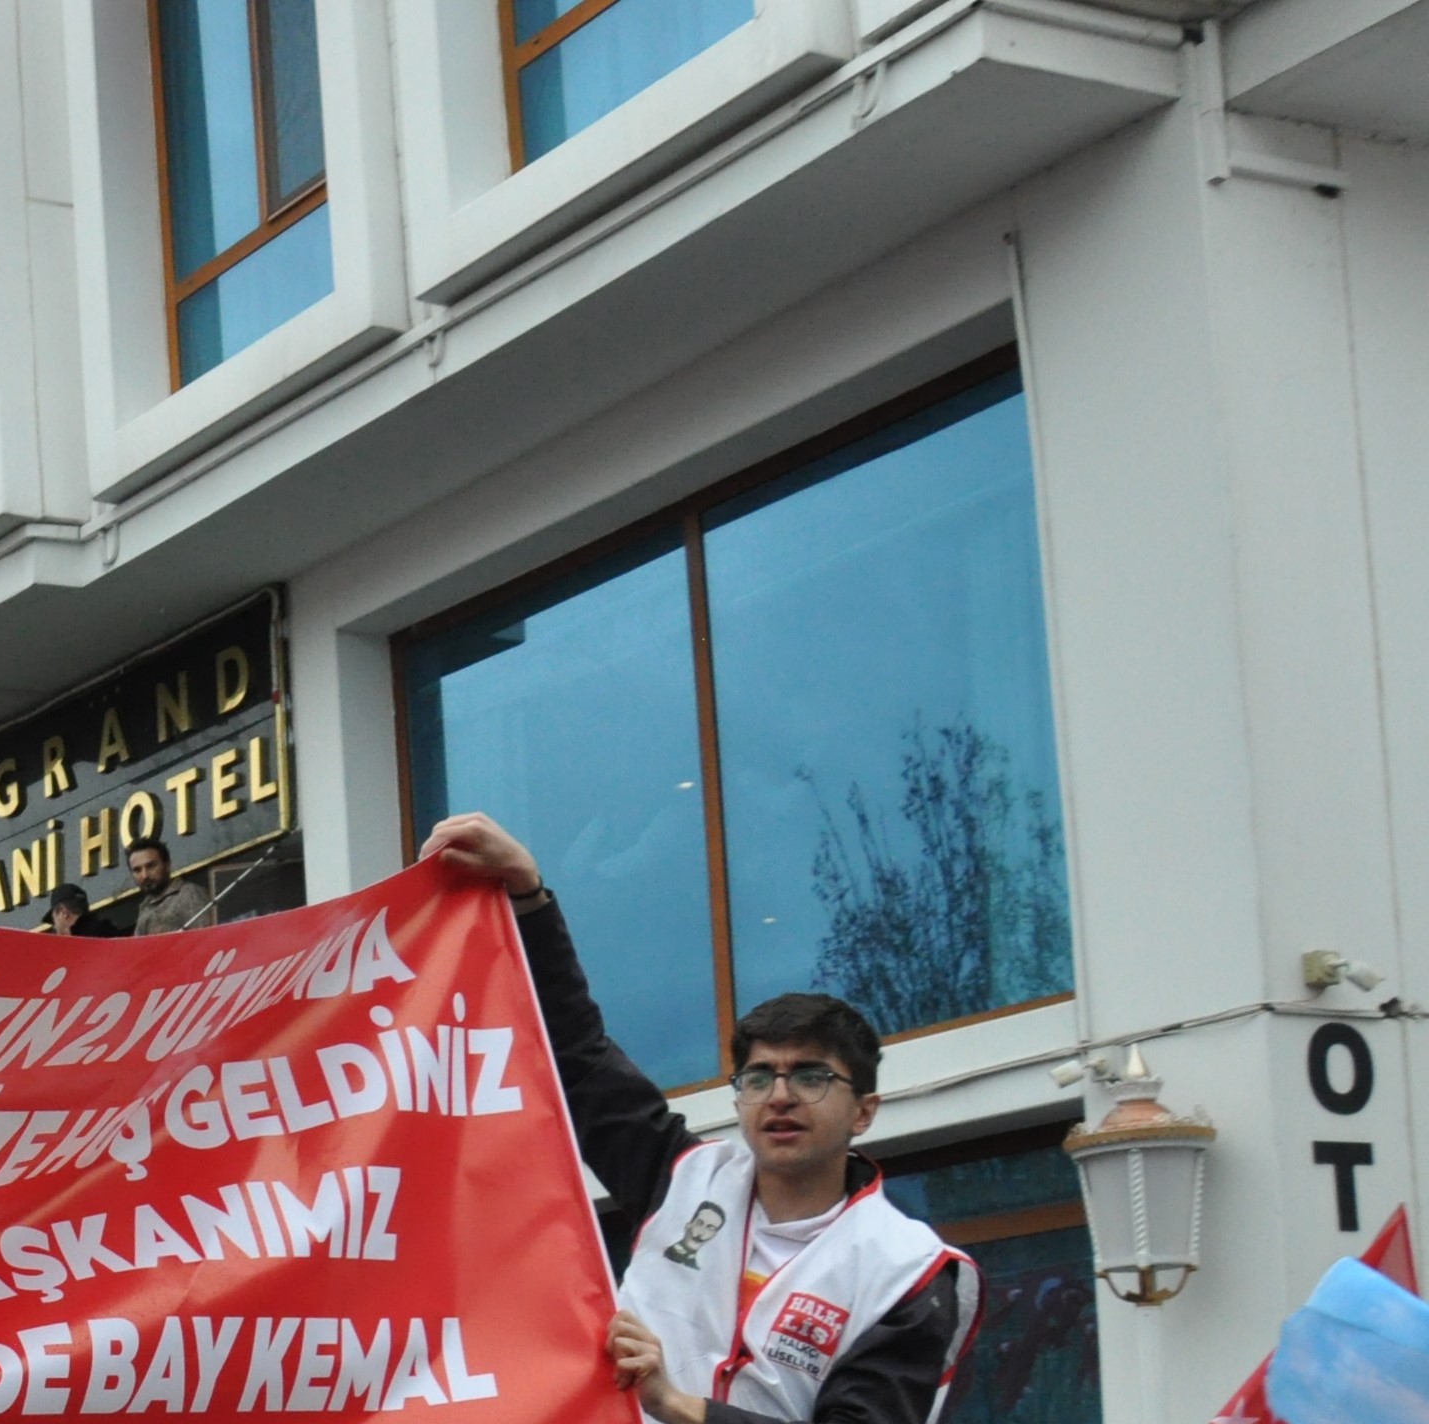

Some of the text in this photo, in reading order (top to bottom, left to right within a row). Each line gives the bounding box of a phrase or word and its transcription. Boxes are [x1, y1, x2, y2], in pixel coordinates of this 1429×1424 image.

[80, 736, 279, 877] HOTEL
[42, 991, 132, 1067] 2.
[164, 992, 523, 1150] GELDİNİZ
[79, 1315, 244, 1414] BAY
[236, 1316, 499, 1413] KEMAL
[779, 1314, 829, 1345] LİS
